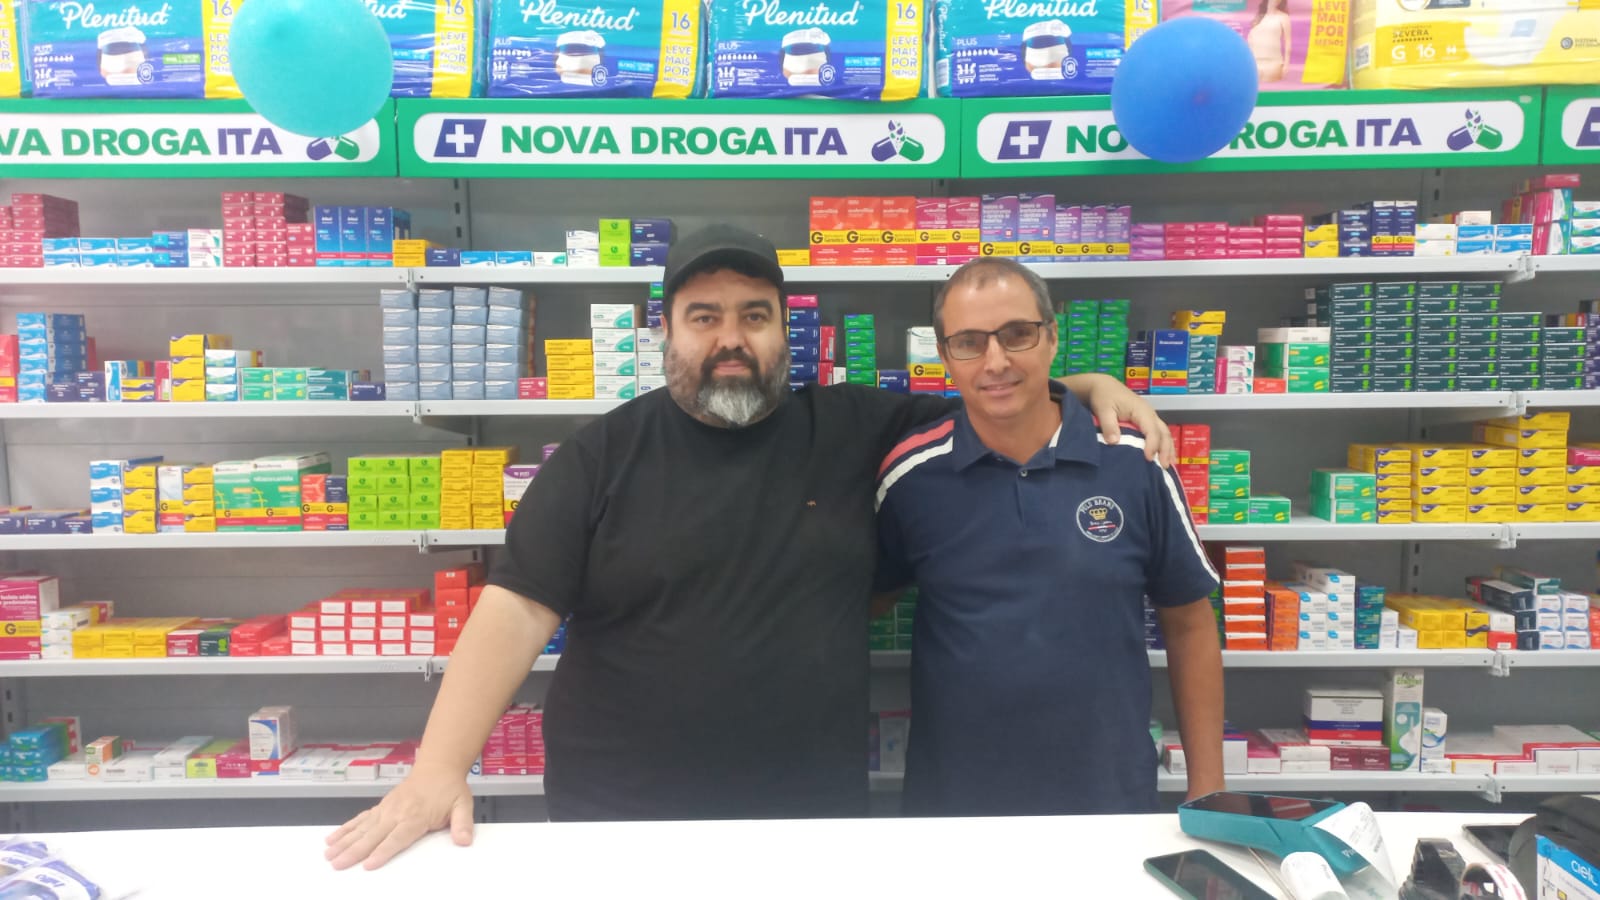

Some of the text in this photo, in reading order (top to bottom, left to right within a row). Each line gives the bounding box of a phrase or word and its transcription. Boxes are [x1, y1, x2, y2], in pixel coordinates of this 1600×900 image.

[59, 1, 169, 29] Plenitud
[520, 0, 635, 30] Plenitud
[743, 0, 859, 26] Plenitud
[896, 3, 916, 19] 16
[671, 12, 691, 29] 16
[1314, 25, 1344, 37] POR
[1393, 29, 1429, 38] SEVERA
[891, 35, 918, 45] LEVE
[956, 37, 978, 46] PLUS
[666, 46, 692, 55] LEVE
[891, 48, 917, 56] MAIS
[1391, 44, 1436, 60] G 16
[211, 55, 230, 64] PO
[665, 56, 690, 66] MAIS
[891, 58, 917, 67] POR
[664, 66, 690, 76] POR
[501, 126, 620, 154] NOVA
[1066, 124, 1130, 153] NO
[1229, 120, 1348, 149] ROGA
[812, 232, 824, 244] G
[847, 230, 859, 243] G
[881, 231, 894, 243] G
[982, 243, 994, 256] G
[1019, 242, 1031, 255] G
[914, 364, 924, 376] G
[5, 623, 17, 635] G
